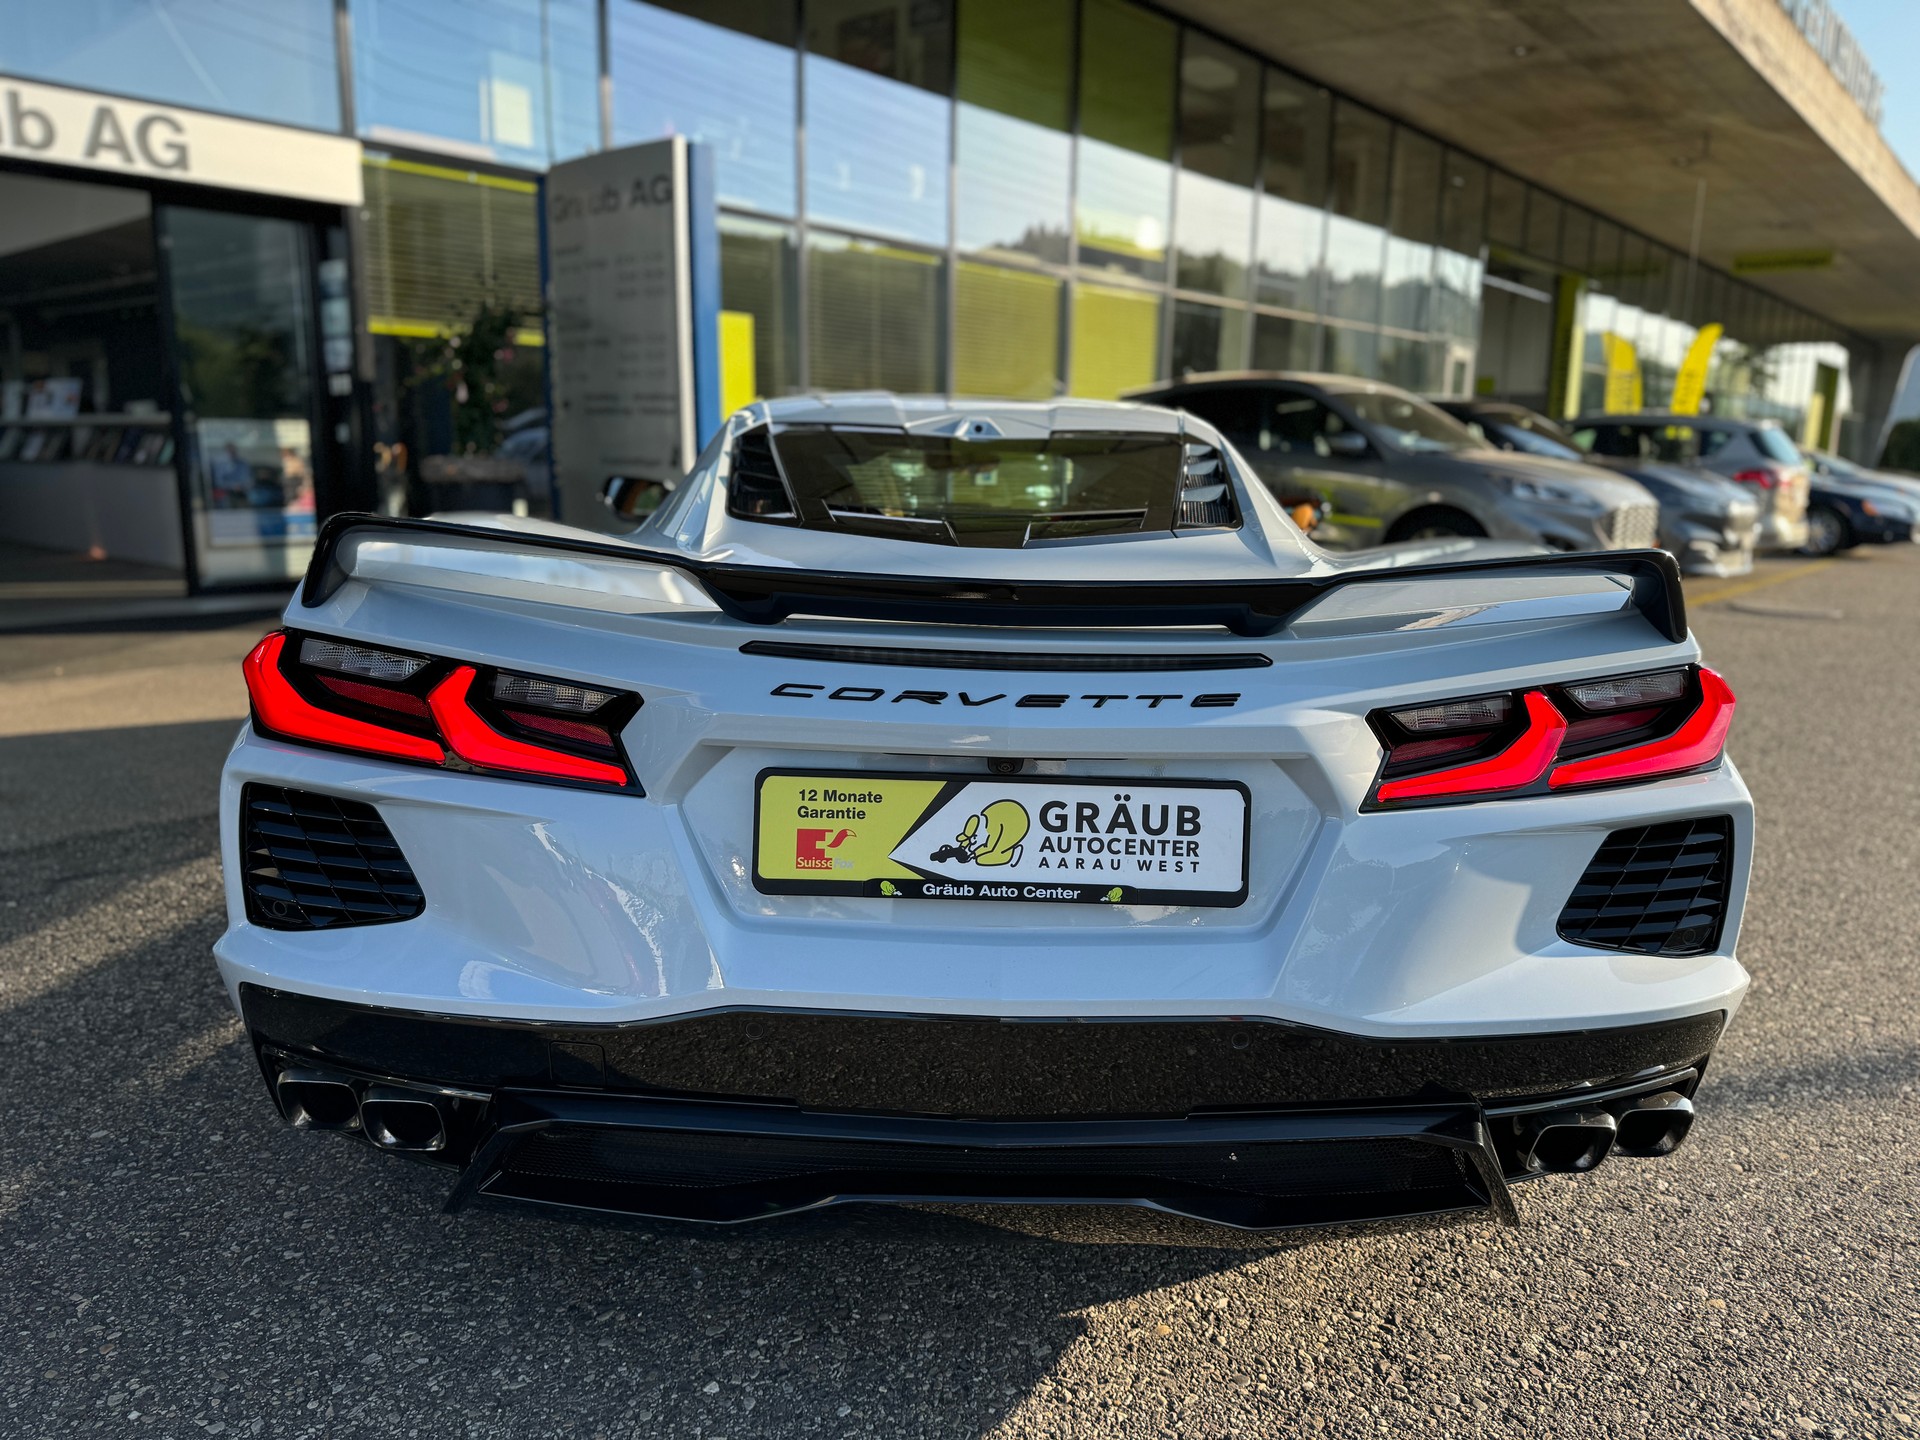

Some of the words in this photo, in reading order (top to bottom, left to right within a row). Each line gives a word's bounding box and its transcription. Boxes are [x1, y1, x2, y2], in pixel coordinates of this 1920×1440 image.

[0, 88, 56, 151] b
[83, 104, 190, 172] AG
[627, 173, 673, 210] AG
[770, 682, 1242, 709] CORVETTE
[799, 788, 818, 802] 12
[823, 789, 883, 804] Monate
[797, 805, 866, 820] Garantie
[1039, 793, 1202, 837] GRÄUB
[1038, 836, 1200, 857] AUTOCENTER
[1038, 857, 1121, 871] AARAU
[1137, 859, 1200, 873] WEST
[922, 883, 975, 896] Gräub
[978, 884, 1018, 898] Auto
[1023, 886, 1081, 899] Center
